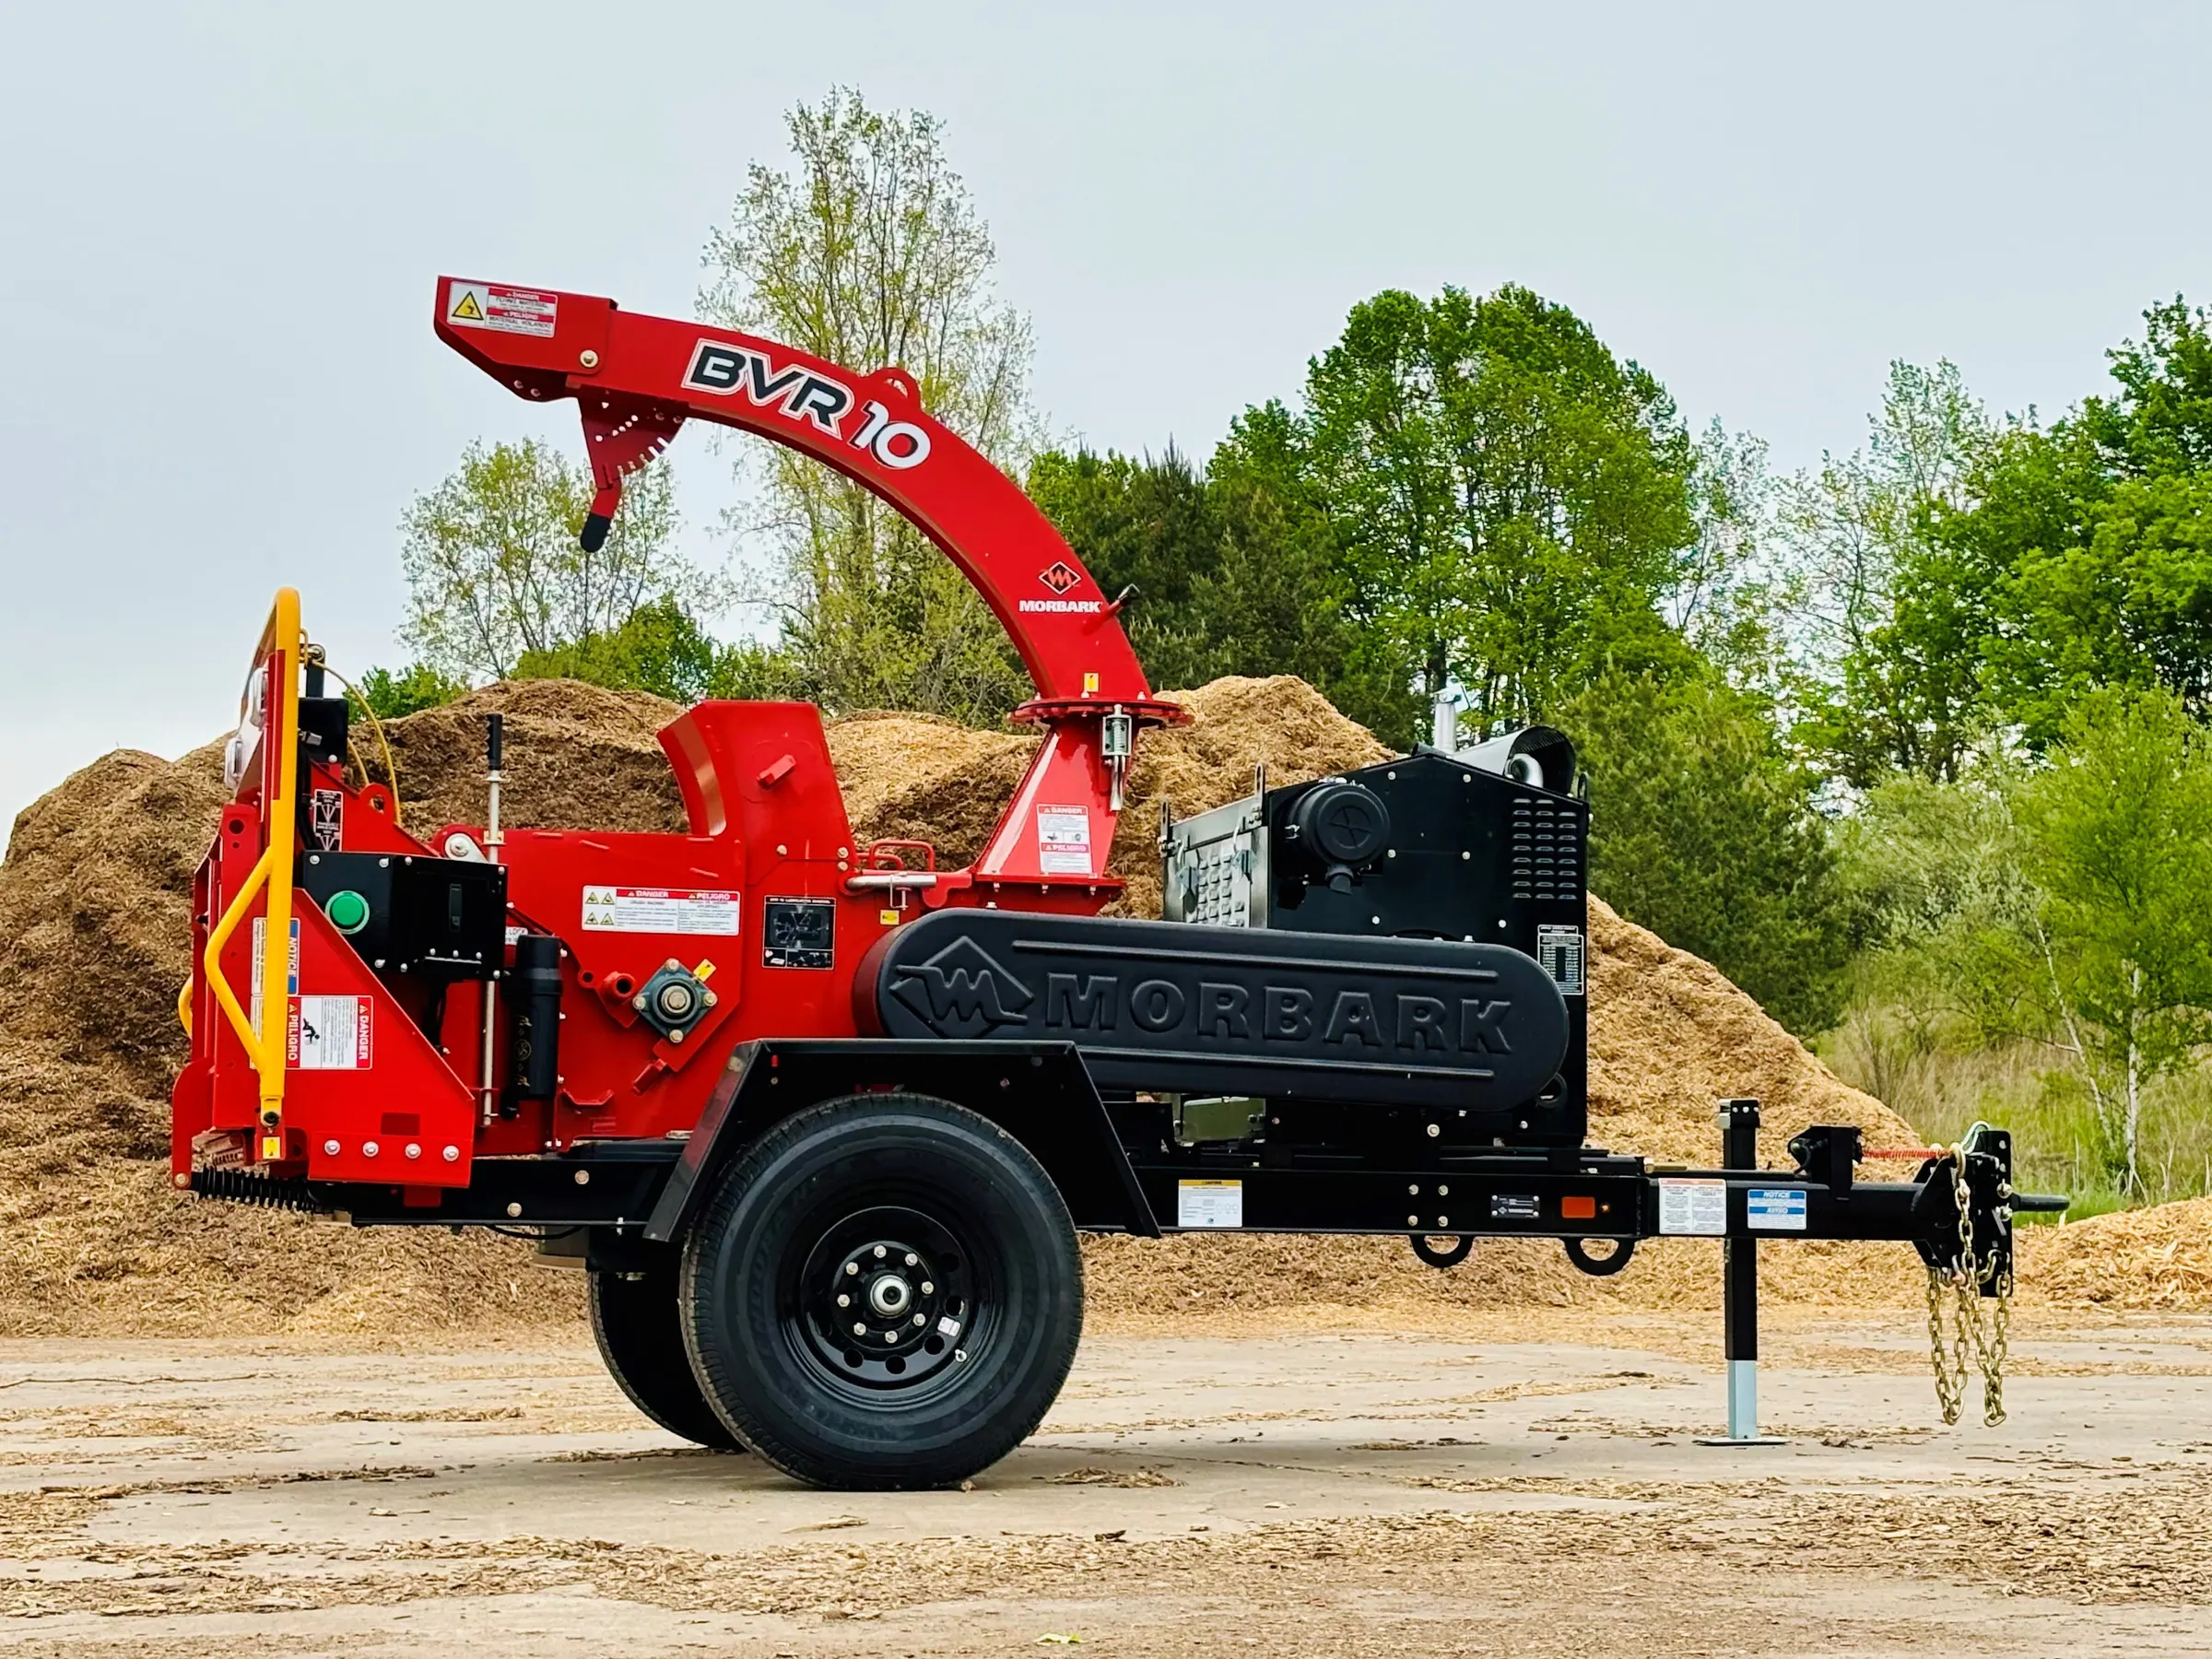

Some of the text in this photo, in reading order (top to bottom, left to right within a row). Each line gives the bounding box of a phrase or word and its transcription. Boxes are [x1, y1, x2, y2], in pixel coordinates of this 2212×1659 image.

[686, 341, 931, 469] BVR 10
[1018, 600, 1101, 613] MORBARK
[635, 890, 669, 899] DANGER
[1046, 971, 1512, 1053] MORBARK
[359, 1017, 370, 1060] DANGER
